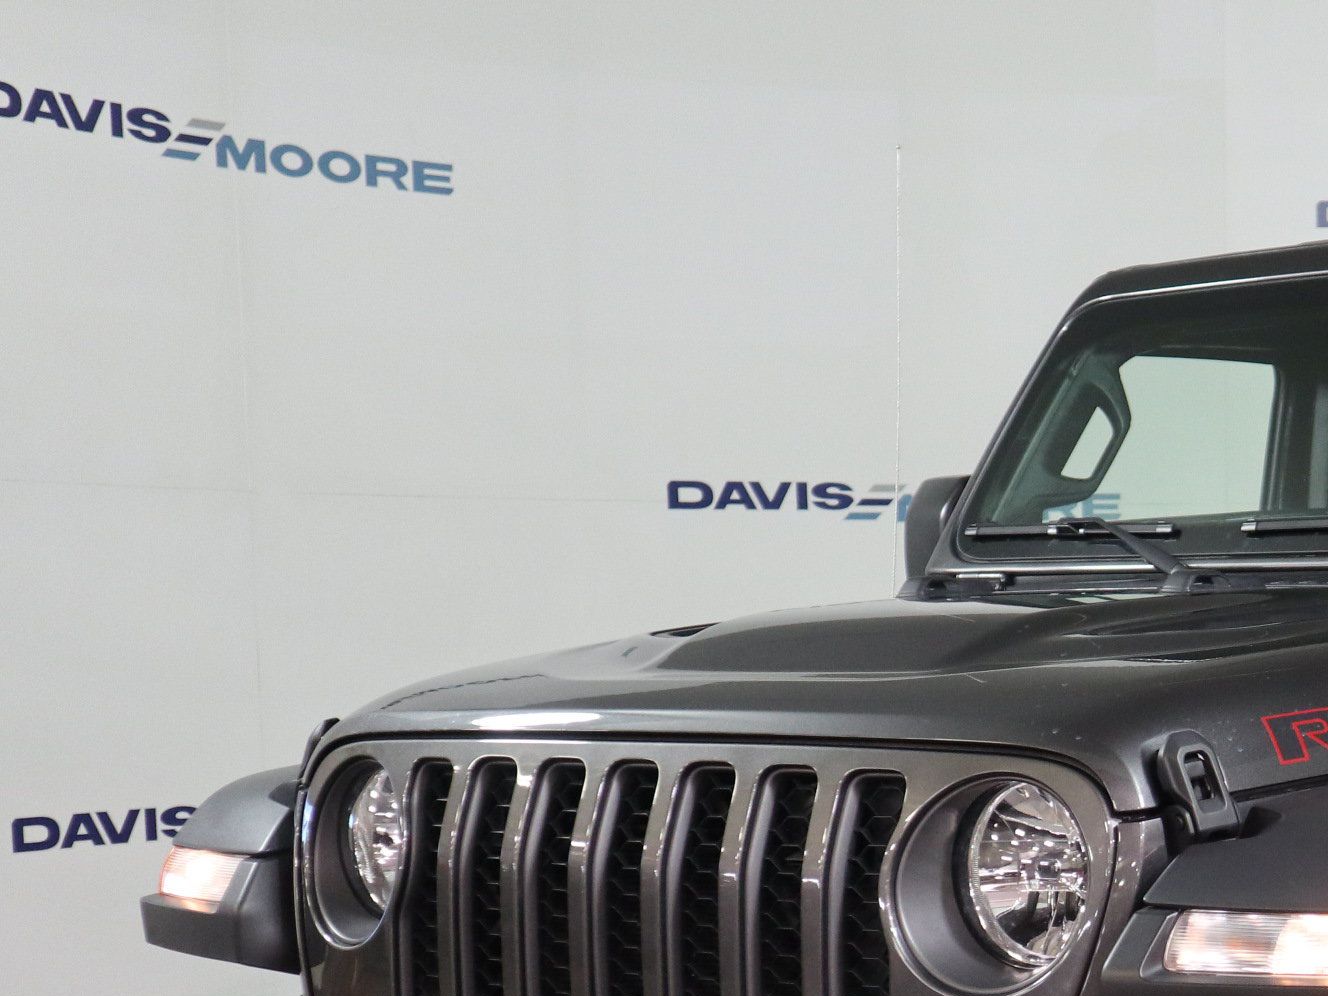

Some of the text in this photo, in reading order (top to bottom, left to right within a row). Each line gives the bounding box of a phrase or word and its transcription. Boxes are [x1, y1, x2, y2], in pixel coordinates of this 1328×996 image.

[216, 135, 454, 195] MOORE
[666, 480, 855, 511] DAVIS
[12, 804, 198, 853] DAVIS
